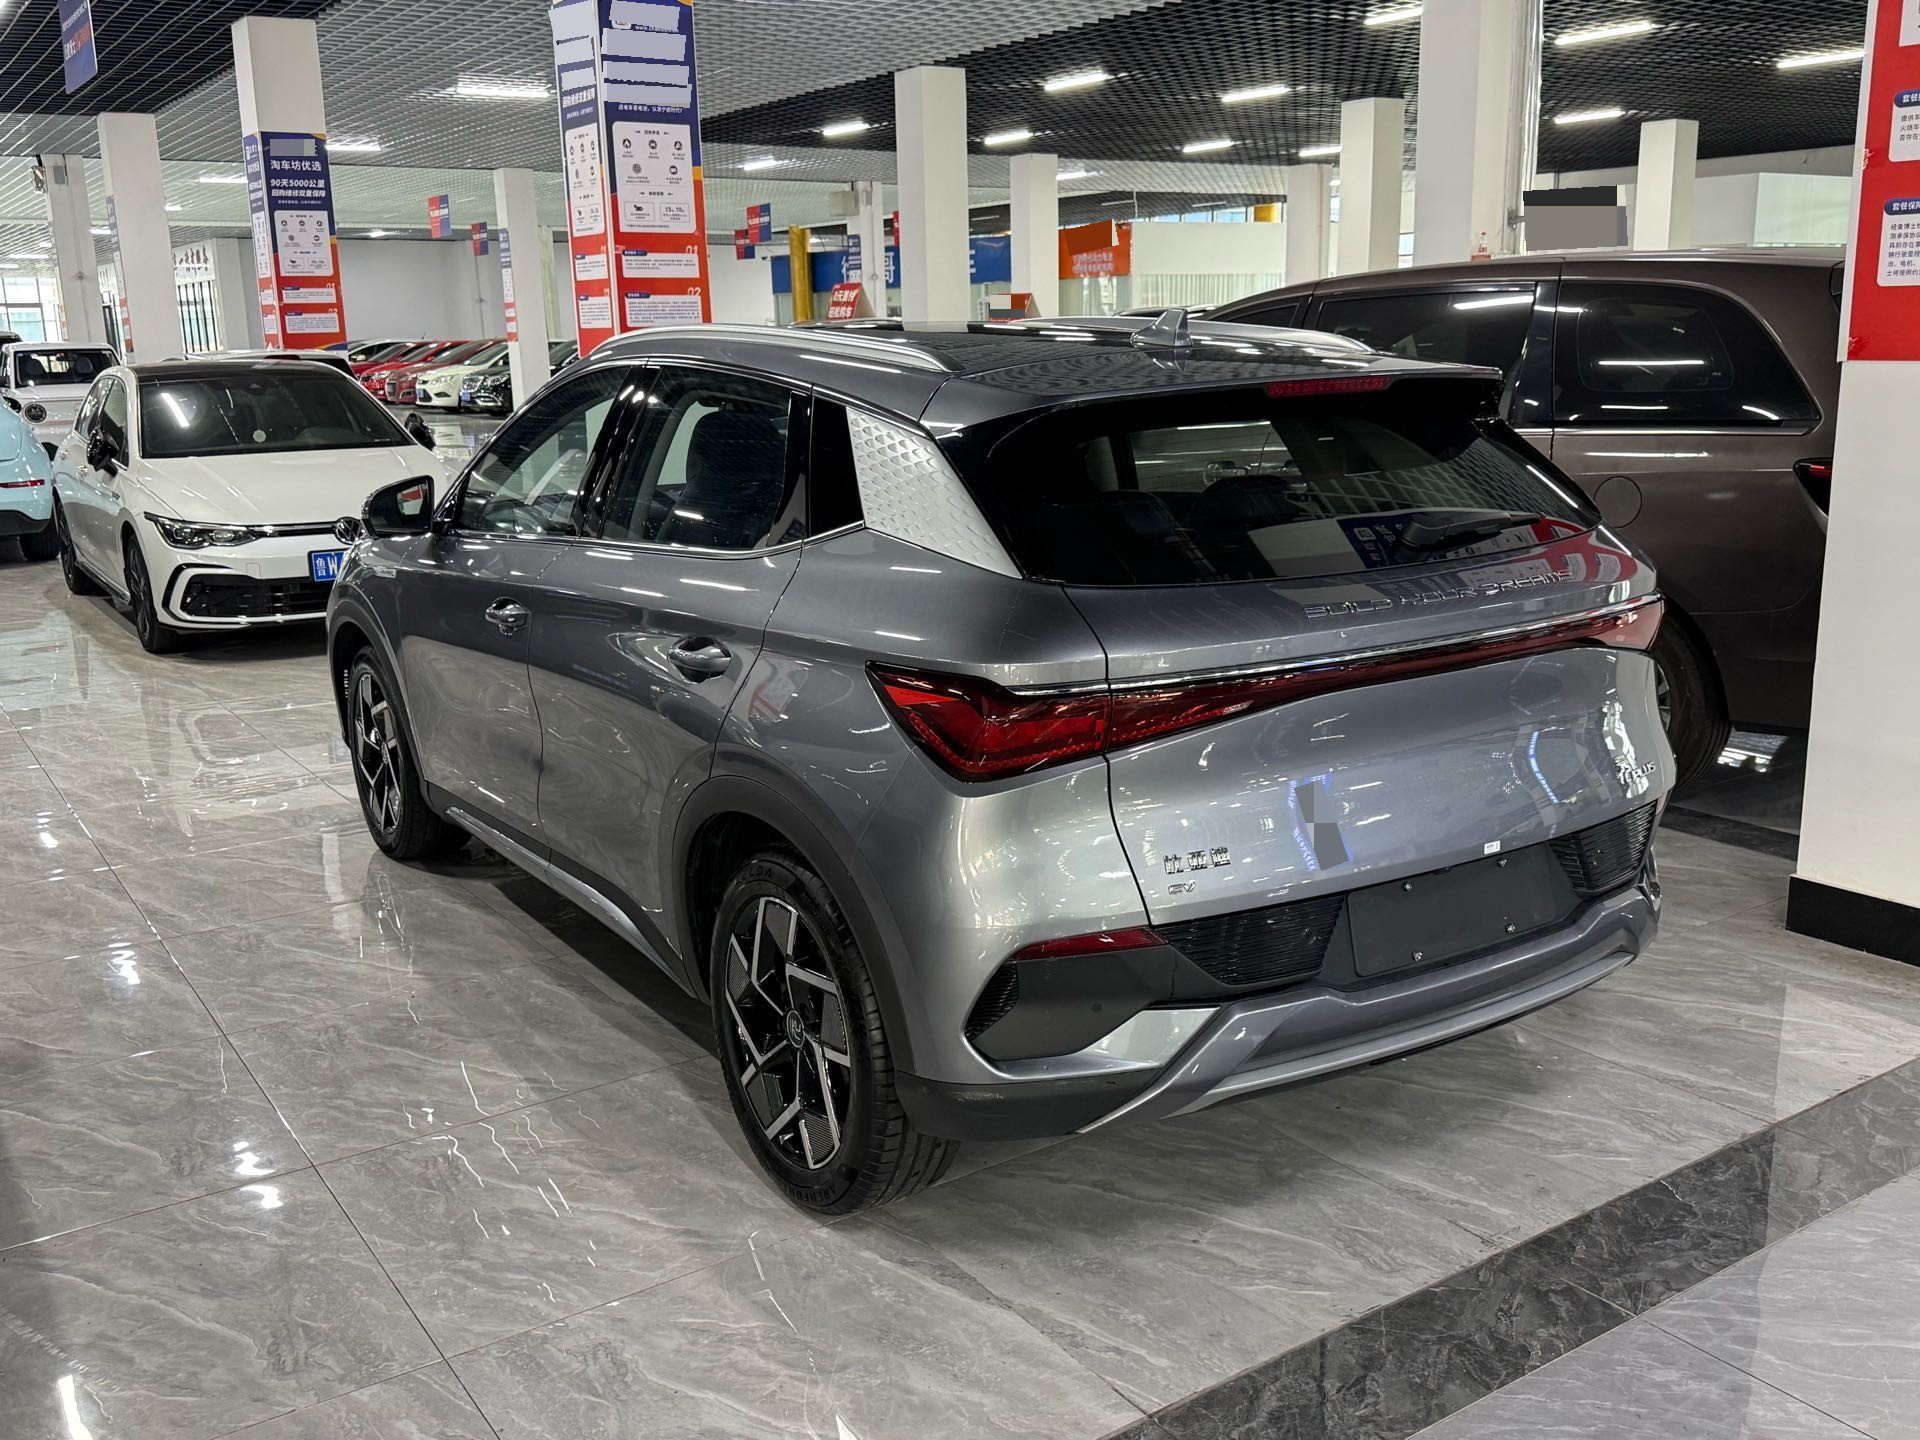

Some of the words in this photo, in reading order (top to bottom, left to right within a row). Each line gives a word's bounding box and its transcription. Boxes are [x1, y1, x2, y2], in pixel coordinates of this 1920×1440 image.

[1902, 93, 1920, 103] 套餐
[270, 160, 322, 171] 淘车坊优选
[270, 179, 325, 188] 90天5000公里
[1304, 598, 1393, 619] BUILD
[1399, 586, 1477, 606] YOUR
[1478, 569, 1573, 596] DREAMS
[1168, 880, 1196, 895] EV
